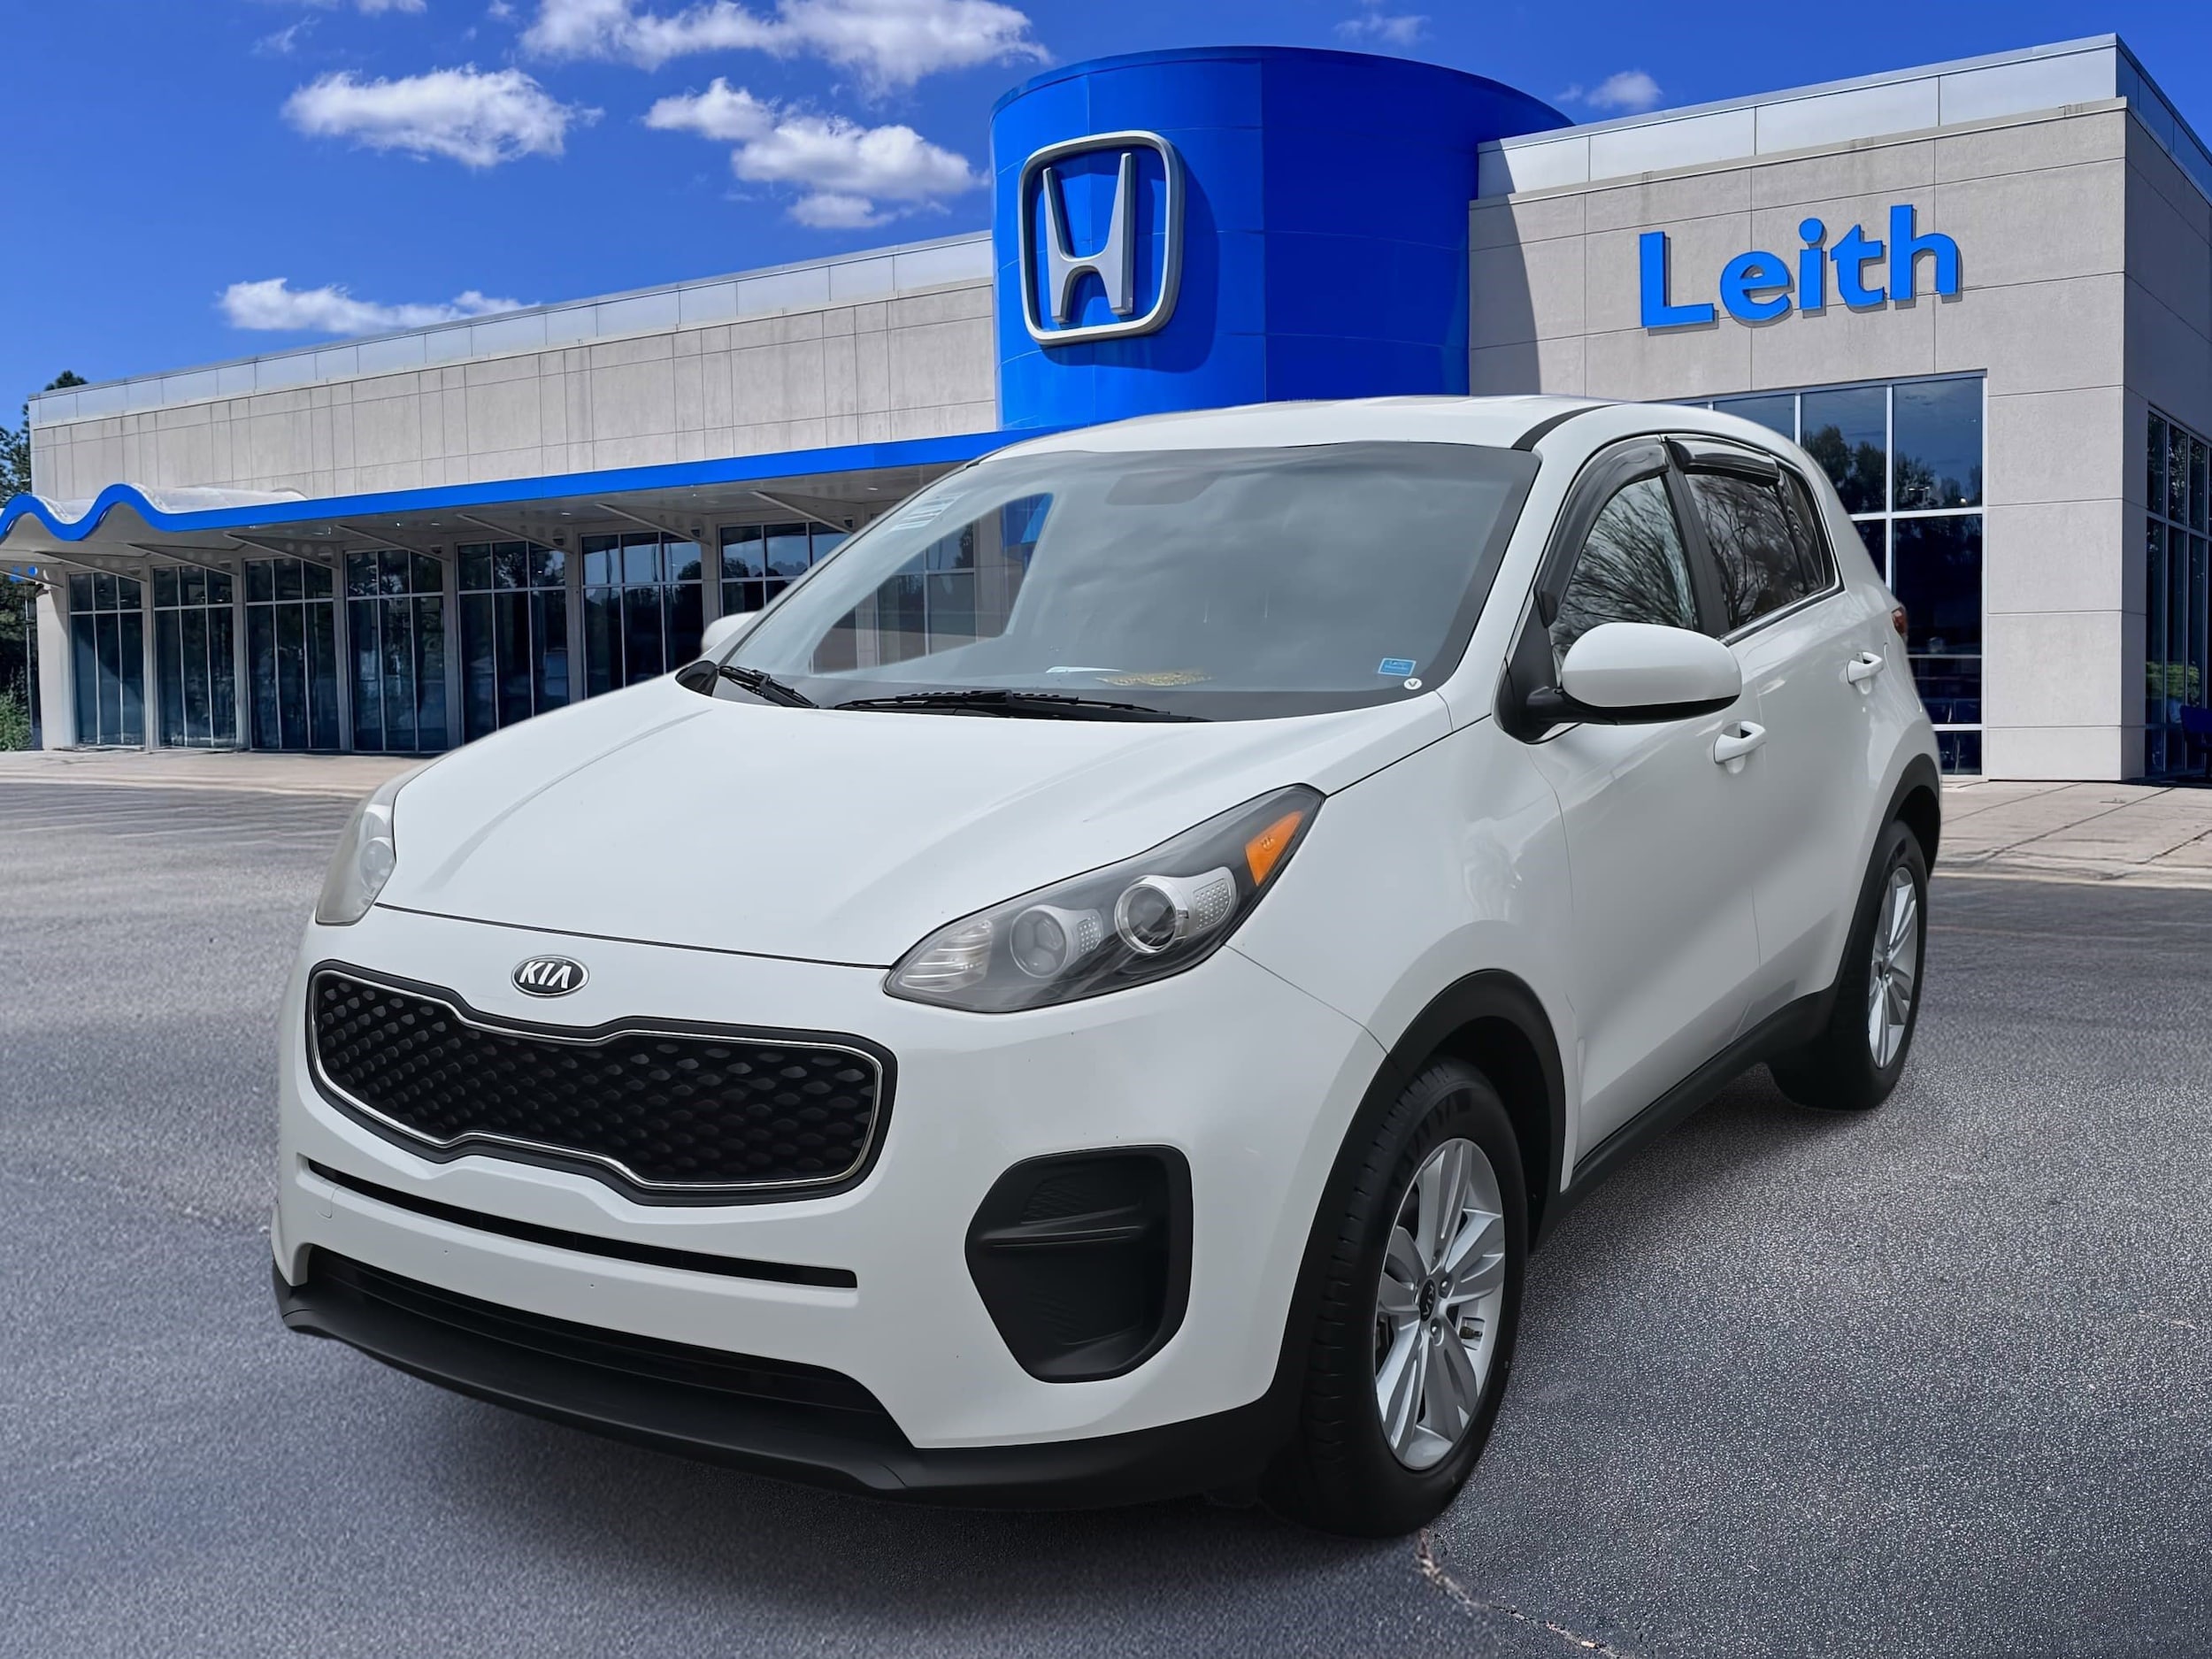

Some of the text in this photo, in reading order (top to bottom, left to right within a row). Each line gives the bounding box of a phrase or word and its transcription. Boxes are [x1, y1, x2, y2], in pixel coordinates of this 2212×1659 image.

[1639, 204, 1961, 331] Leith
[518, 961, 572, 989] KIA
[1423, 1285, 1434, 1316] KIA
